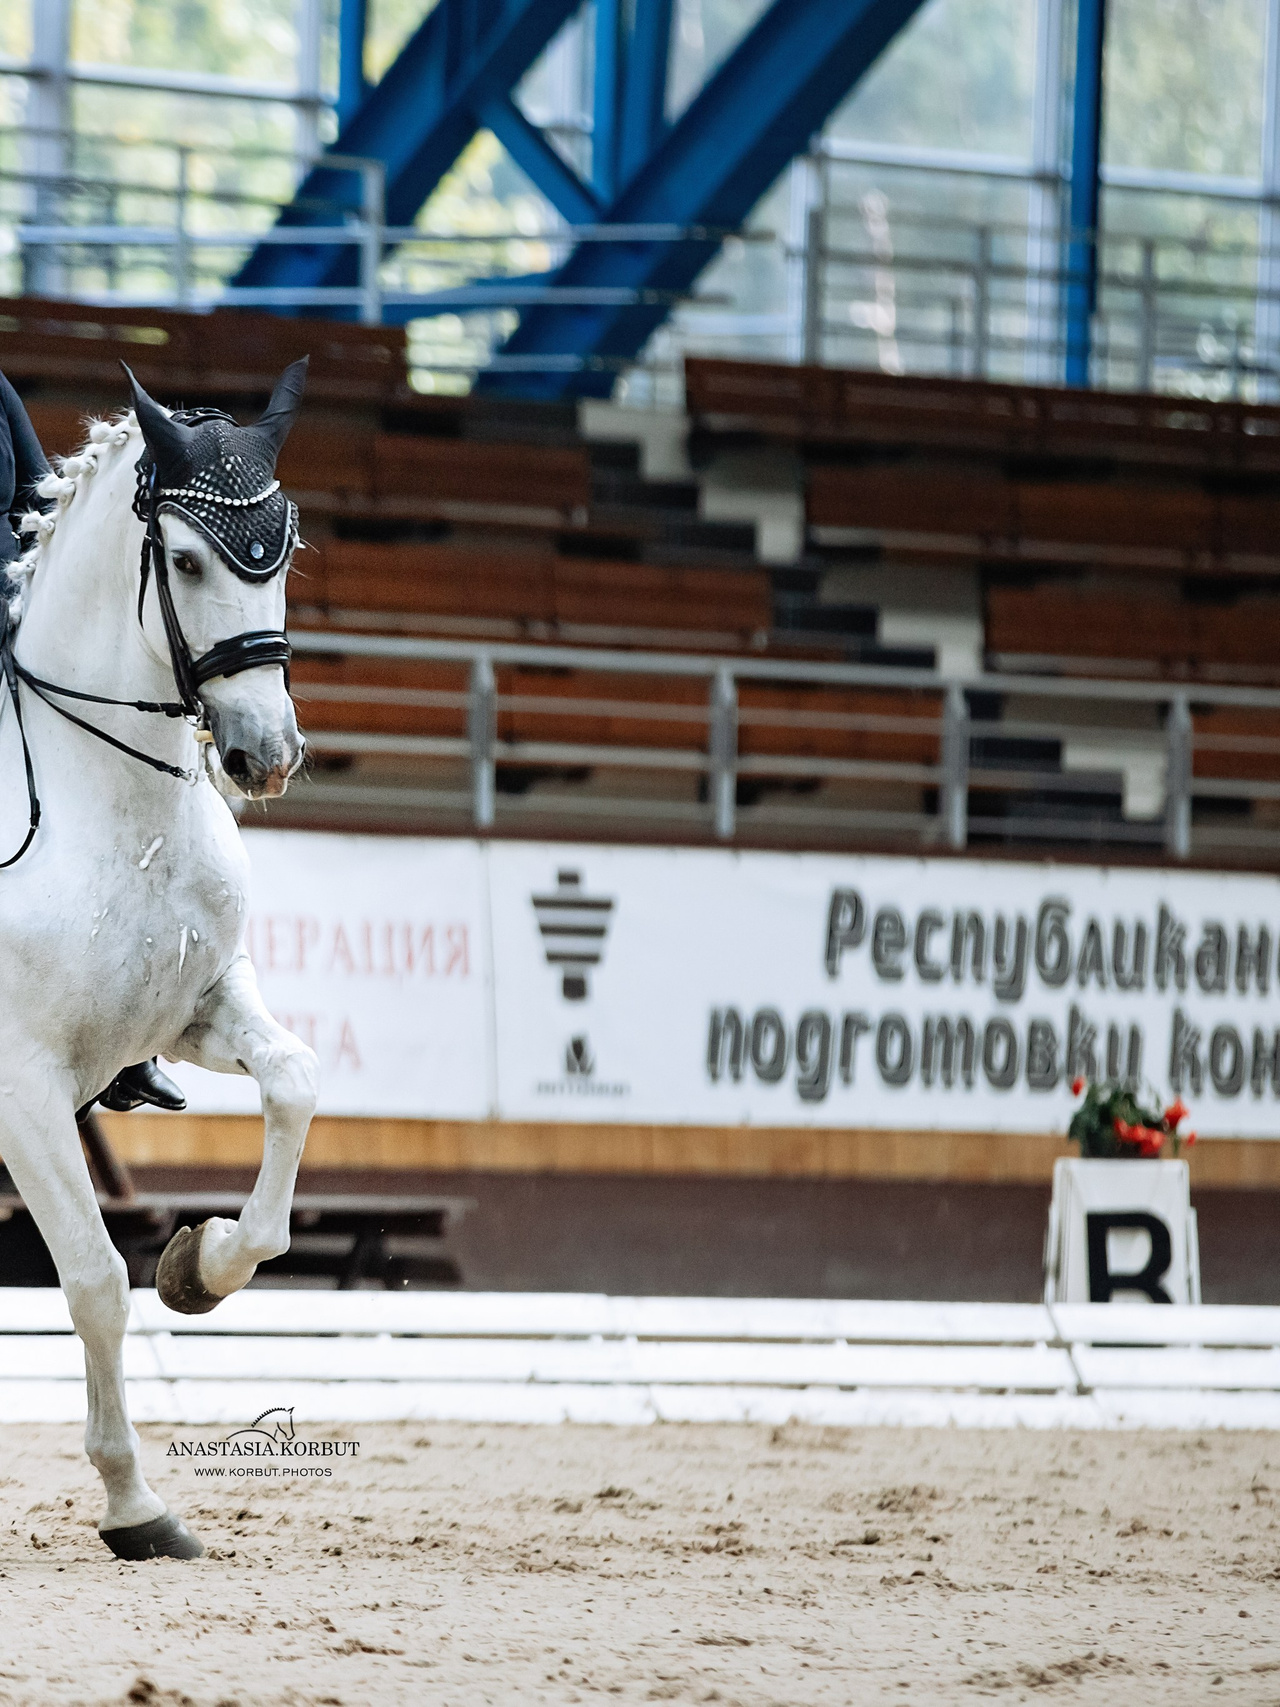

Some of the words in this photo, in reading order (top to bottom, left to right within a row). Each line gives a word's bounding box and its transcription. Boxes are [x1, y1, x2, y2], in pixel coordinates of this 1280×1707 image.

[824, 886, 1280, 1003] Республикан
[706, 1003, 1142, 1105] подготовки
[1086, 1210, 1173, 1304] R
